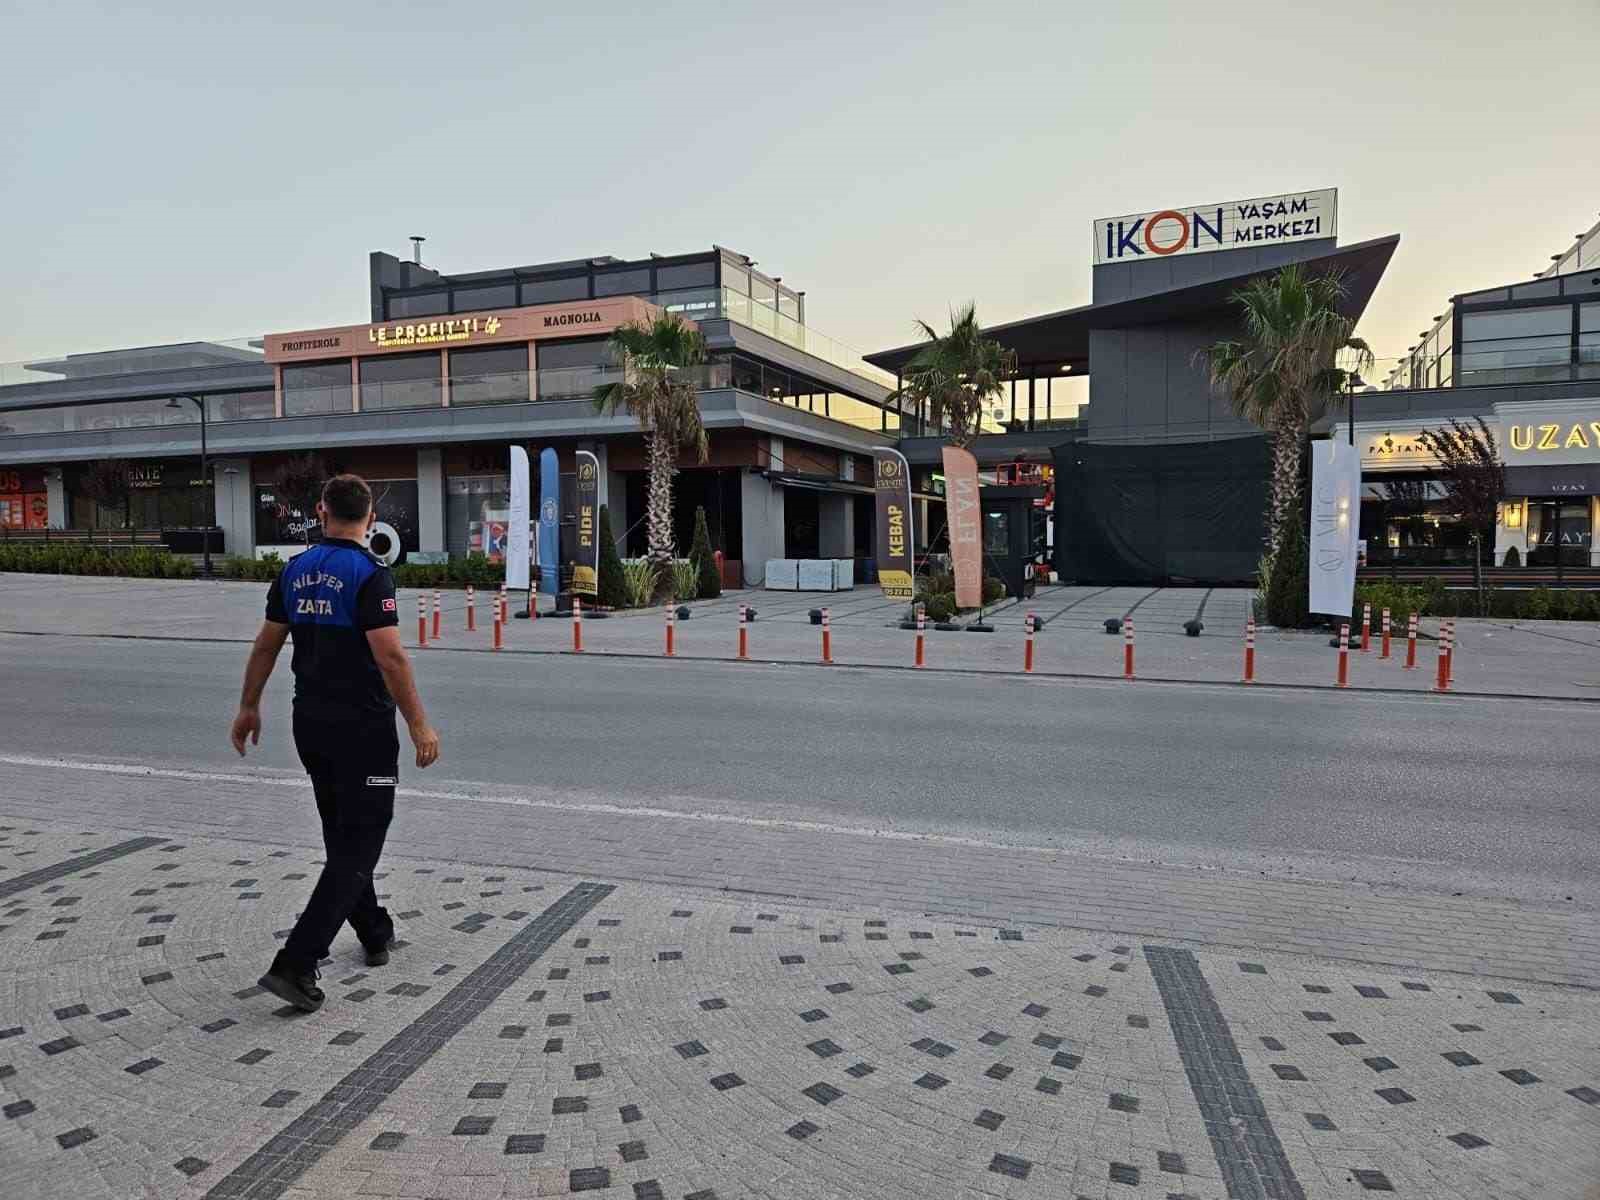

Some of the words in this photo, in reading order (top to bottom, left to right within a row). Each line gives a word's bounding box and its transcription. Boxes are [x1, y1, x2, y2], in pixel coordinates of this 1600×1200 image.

[1237, 198, 1308, 219] YAŞAM
[543, 312, 601, 327] MAGNOLIA
[370, 327, 386, 342] LE
[280, 338, 340, 351] PROFITEROLE
[888, 505, 904, 557] KEBAP
